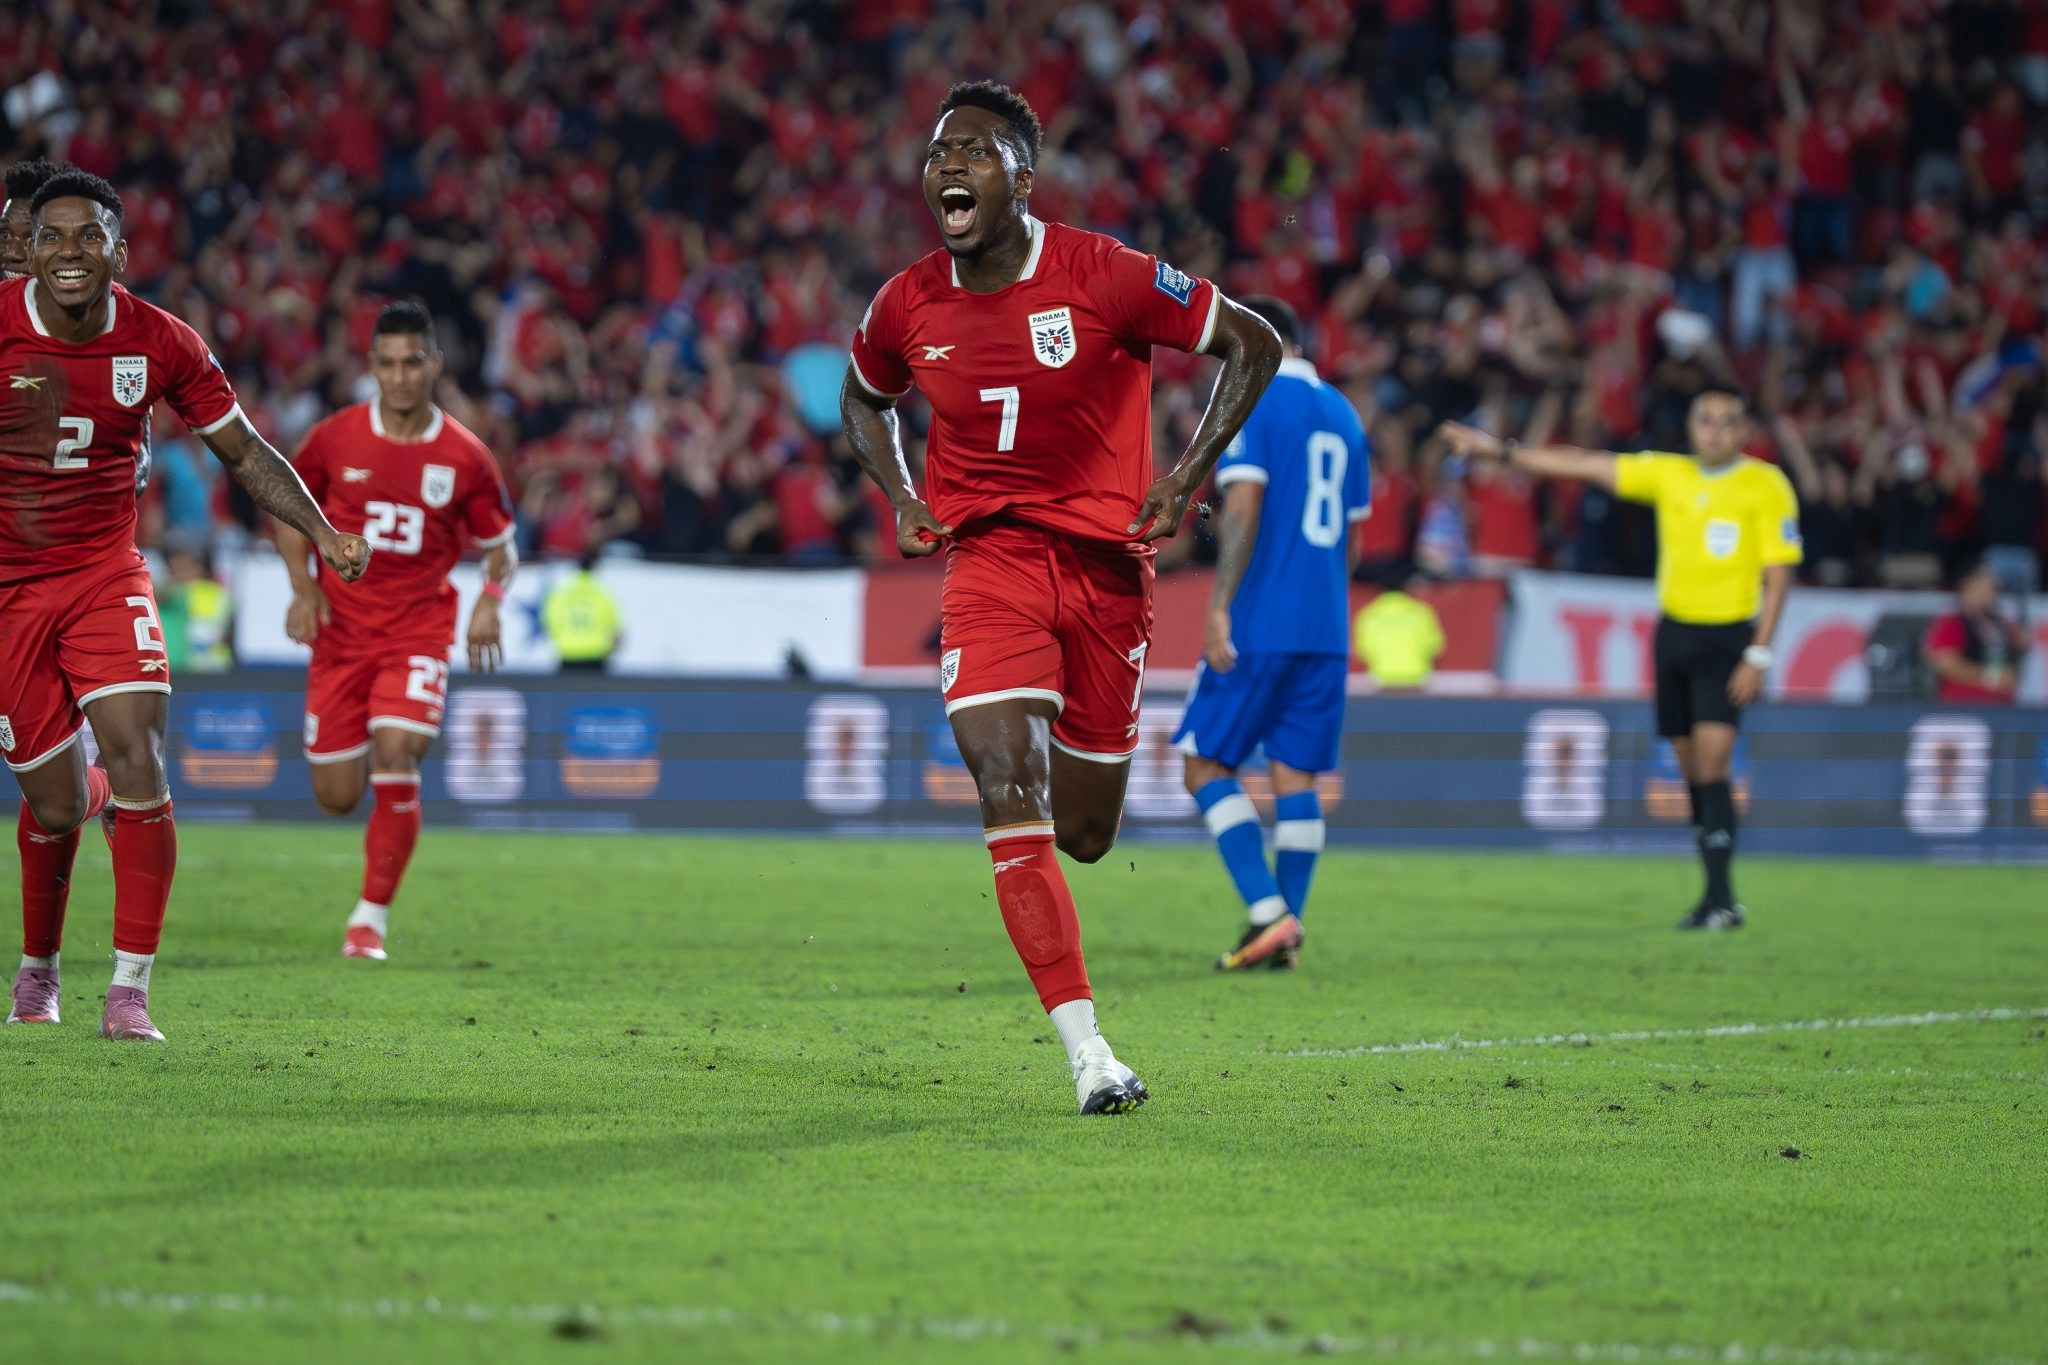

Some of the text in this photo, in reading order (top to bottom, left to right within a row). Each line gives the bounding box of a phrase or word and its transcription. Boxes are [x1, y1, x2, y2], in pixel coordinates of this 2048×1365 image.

[54, 416, 94, 469] 2
[979, 386, 1019, 451] 7
[1301, 430, 1348, 548] 8
[363, 500, 425, 555] 23
[125, 596, 163, 651] 2
[1128, 641, 1147, 712] 7
